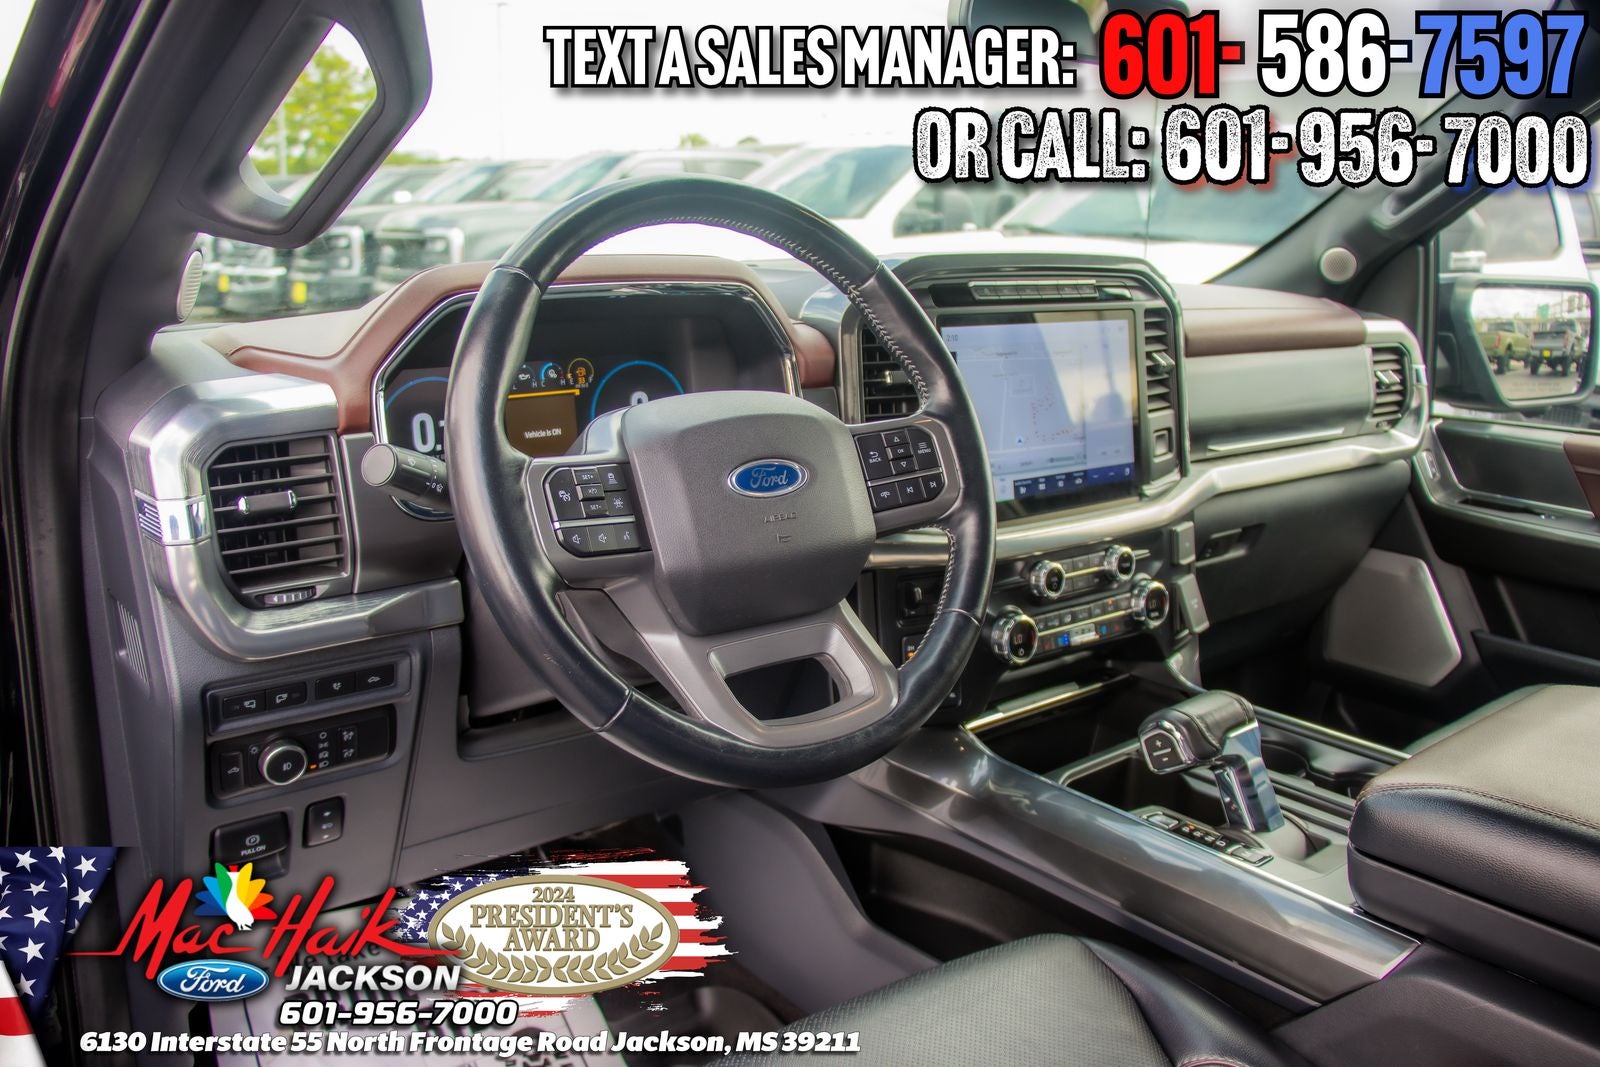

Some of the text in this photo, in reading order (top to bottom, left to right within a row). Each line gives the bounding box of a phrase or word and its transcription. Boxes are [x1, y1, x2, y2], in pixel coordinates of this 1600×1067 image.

[412, 412, 445, 453] 0.
[524, 430, 546, 439] Vehicle
[749, 466, 789, 489] Ford
